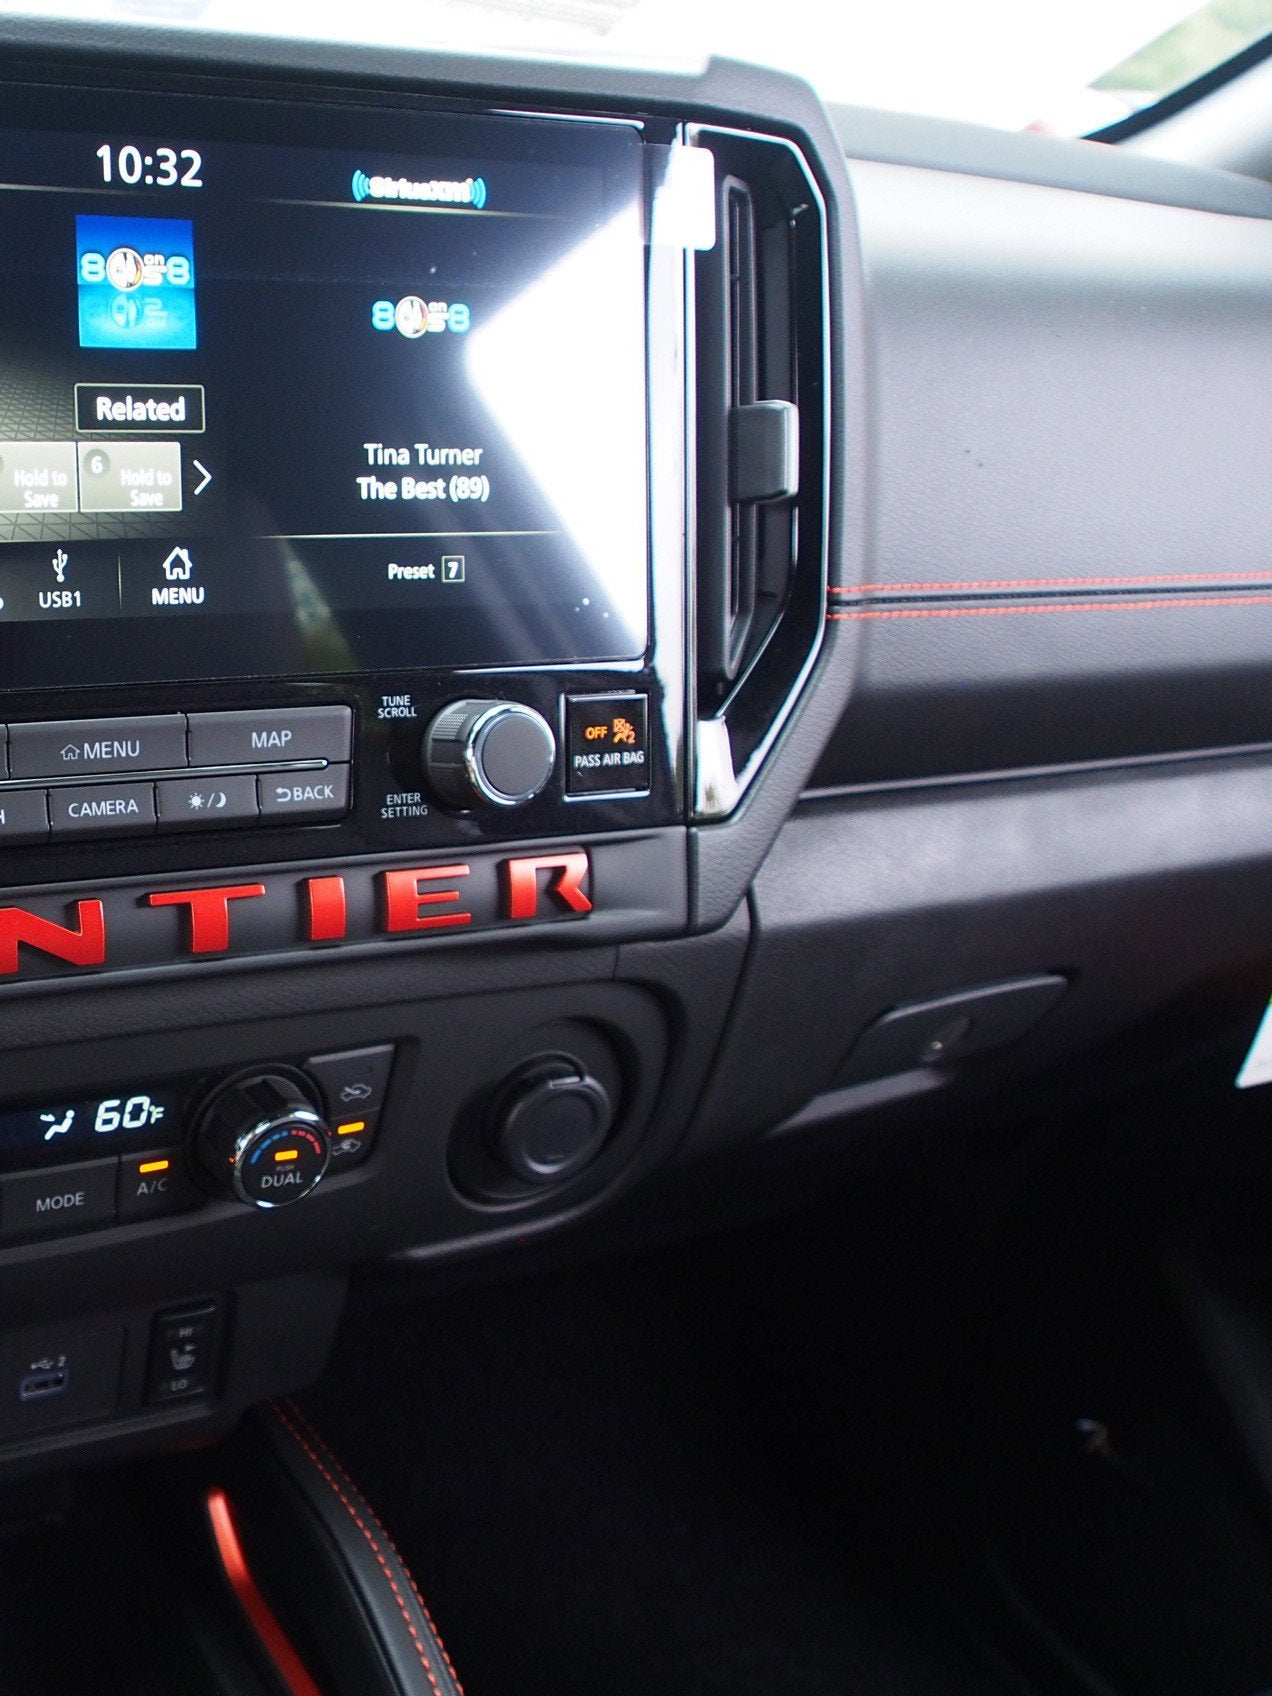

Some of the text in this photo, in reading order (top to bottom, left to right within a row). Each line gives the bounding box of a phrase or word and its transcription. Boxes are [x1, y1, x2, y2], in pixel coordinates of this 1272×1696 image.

[97, 145, 203, 188] 10:32
[96, 396, 186, 422] Related
[363, 443, 483, 466] Tina Turner
[90, 456, 103, 474] 6
[14, 469, 68, 487] Hold to
[121, 468, 173, 487] Hold to
[356, 475, 490, 502] The Best (89)
[23, 490, 58, 508] Save
[130, 489, 164, 507] Save
[388, 562, 458, 581] Preset 7
[38, 591, 81, 608] USB1
[151, 587, 205, 606] MENU
[381, 695, 411, 707] TUNE
[378, 706, 417, 719] SCROLL
[251, 731, 292, 748] MAP
[585, 726, 607, 740] OFF
[84, 740, 140, 759] MENU
[575, 750, 644, 767] PASS AIR BAG
[293, 785, 334, 801] BACK
[386, 793, 421, 805] ENTER
[68, 799, 139, 818] CAMERA
[381, 804, 428, 819] SETTING
[137, 1178, 167, 1197] A/C
[261, 1171, 303, 1188] DUAL
[36, 1192, 84, 1213] MODE
